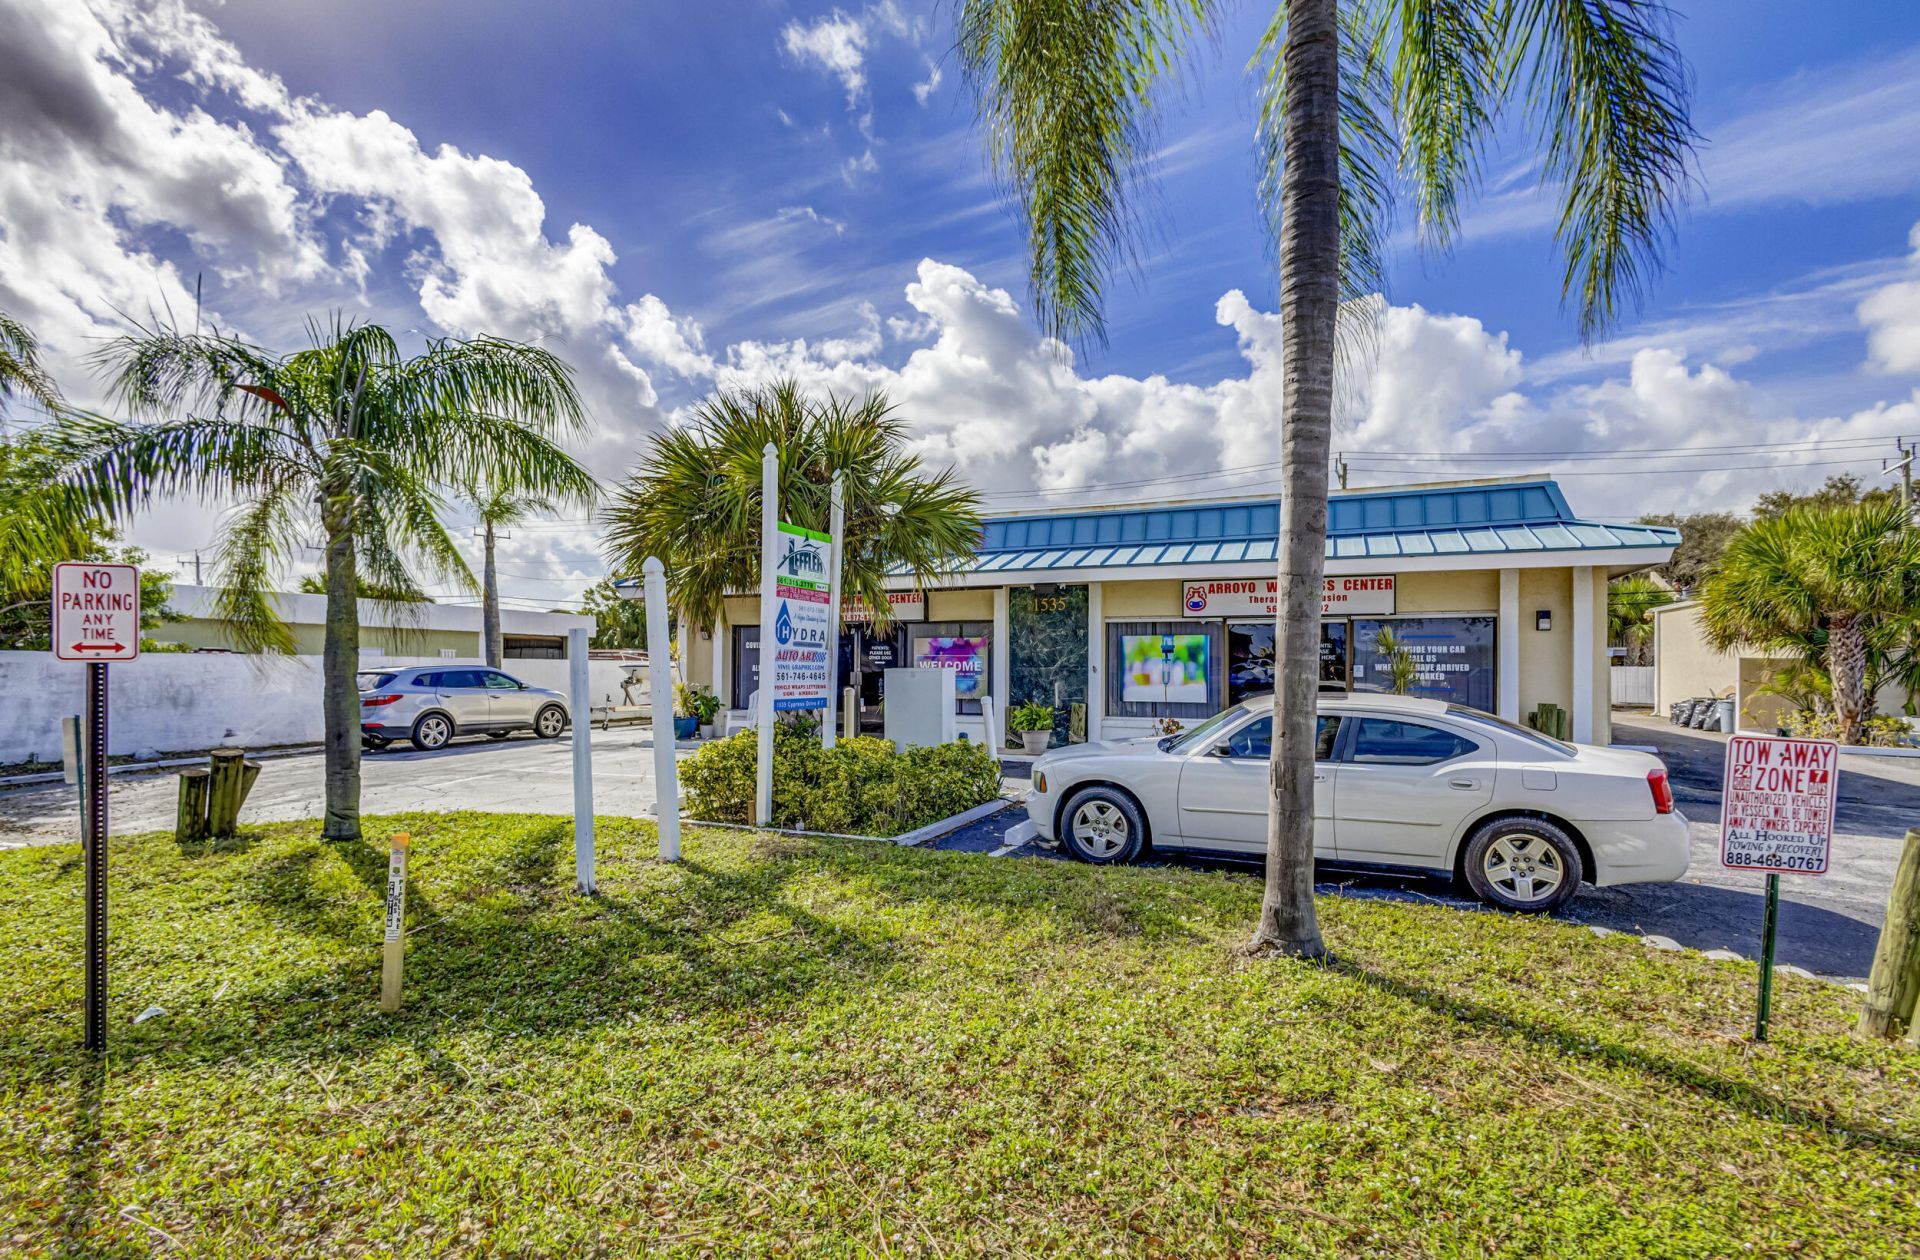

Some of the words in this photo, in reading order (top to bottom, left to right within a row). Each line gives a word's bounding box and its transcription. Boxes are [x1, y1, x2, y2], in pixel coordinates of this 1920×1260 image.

[83, 571, 112, 589] NO
[1344, 578, 1393, 591] CENTER
[1208, 581, 1256, 594] ARROYO
[62, 592, 132, 611] PARKING
[1032, 597, 1067, 612] 1535
[82, 613, 113, 626] ANY
[81, 627, 115, 640] TIME
[775, 650, 799, 661] AUTO
[1426, 645, 1448, 654] YOUR
[1449, 645, 1466, 654] CAR
[1426, 654, 1437, 663] US
[919, 660, 982, 672] WELCOME
[1435, 663, 1470, 672] ARRIVED
[776, 672, 826, 681] 561-746-4645
[1416, 672, 1445, 681] PARKED
[1734, 740, 1772, 766] TOW
[1779, 743, 1833, 769] AWAY
[1735, 764, 1752, 778] 24
[1813, 770, 1825, 783] 7
[1754, 767, 1805, 793] ZONE
[1730, 791, 1788, 806] UNAUTHORIZED
[1791, 796, 1829, 809] VEHICLES
[1728, 803, 1739, 816] OR
[1741, 805, 1770, 817] VESSELS
[1773, 806, 1789, 819] WILL
[1791, 807, 1801, 820] BE
[1804, 808, 1827, 822] TOWED
[1728, 816, 1747, 830] AWAY
[1760, 818, 1791, 832] OWNERS
[1793, 820, 1827, 834] EXPENSE
[1755, 830, 1805, 843] HOOKED
[1727, 840, 1765, 852] TOWING
[1774, 844, 1825, 858] RECOVERY
[1726, 851, 1824, 871] 888-468-0767
